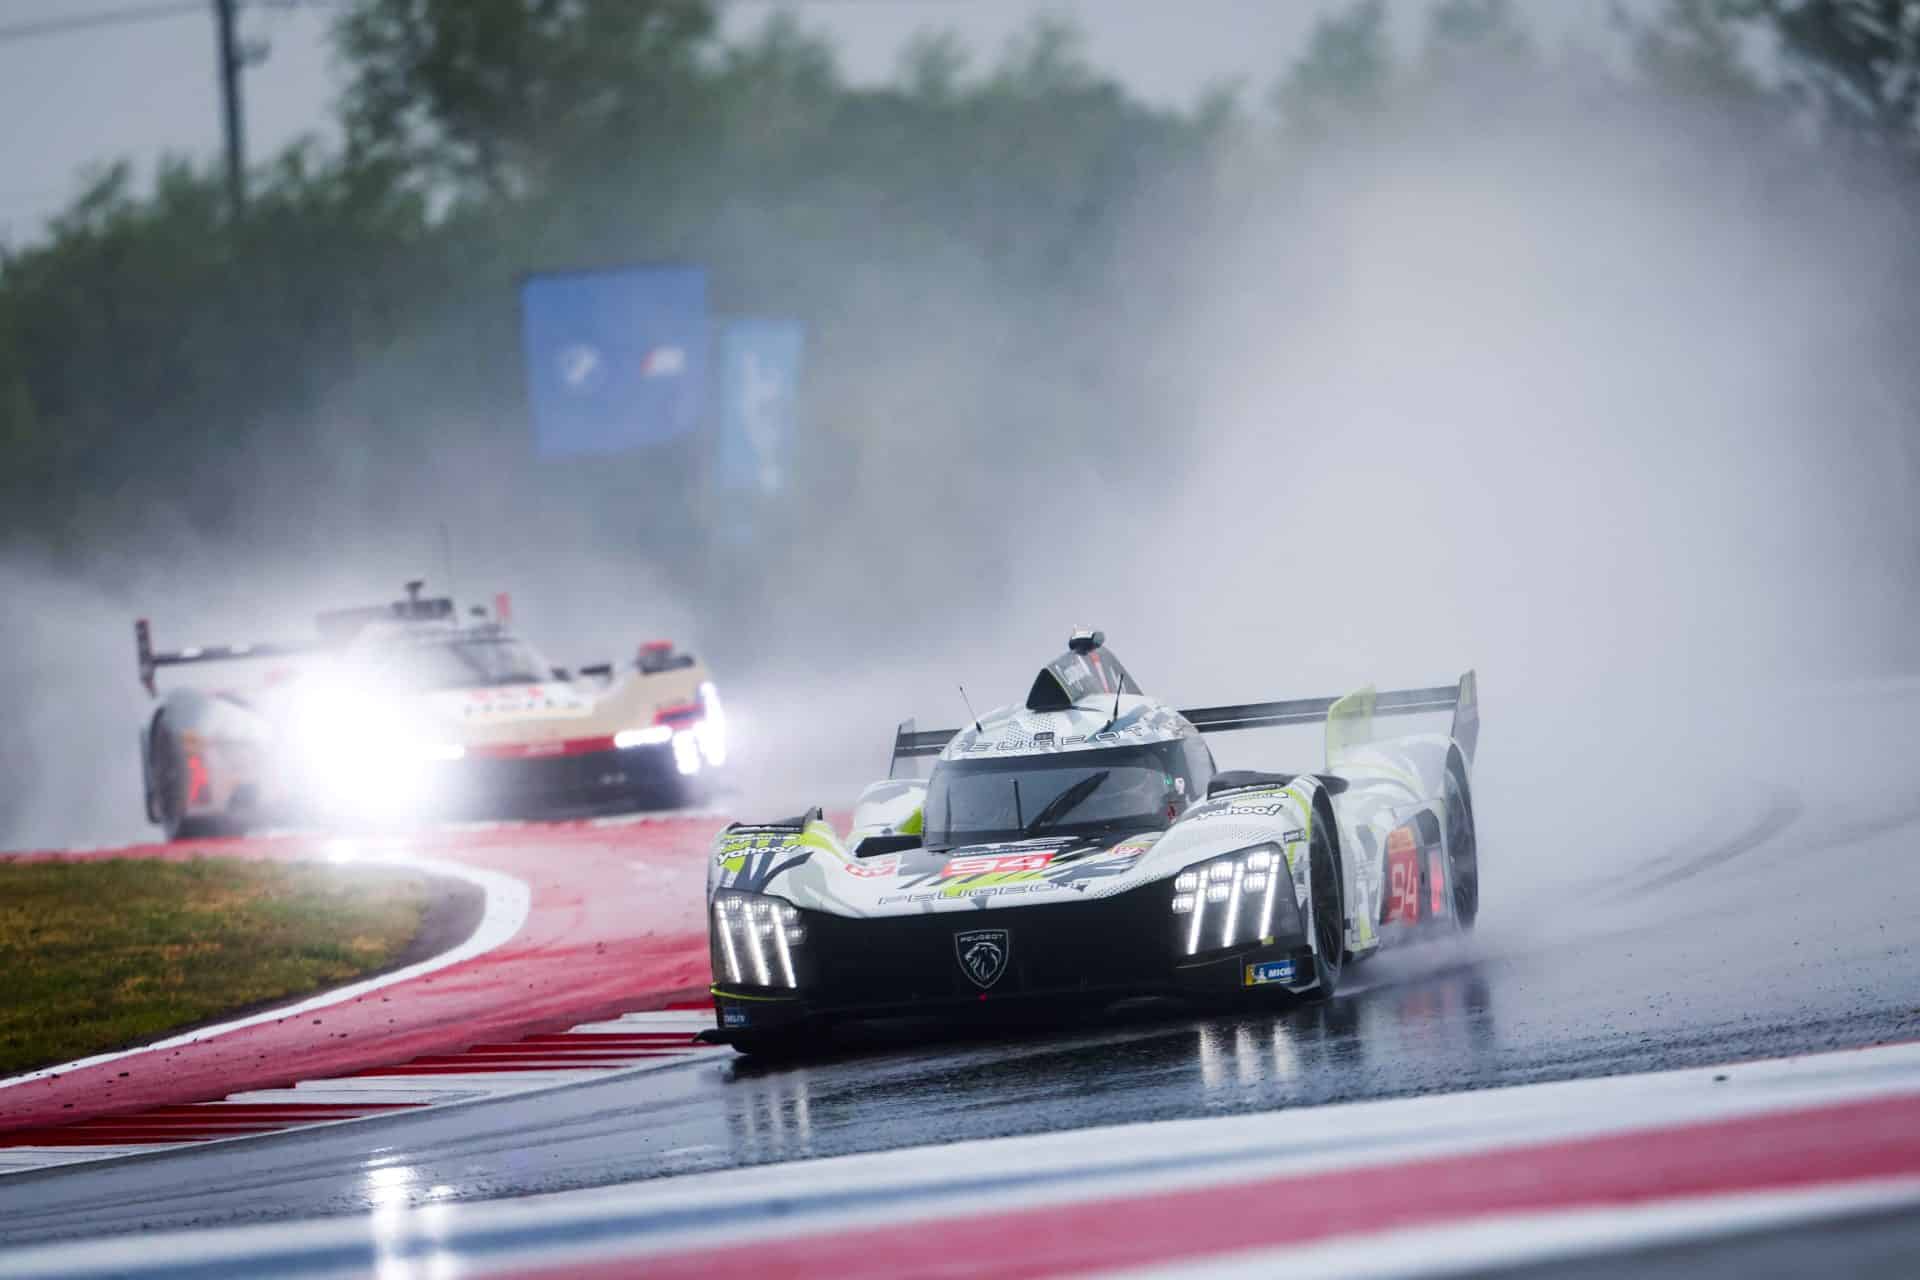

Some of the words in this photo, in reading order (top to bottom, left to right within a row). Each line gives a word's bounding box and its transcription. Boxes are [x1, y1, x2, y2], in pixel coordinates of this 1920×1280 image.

[1199, 803, 1282, 821] yahoo!
[949, 855, 1049, 875] 94
[1389, 860, 1418, 918] 94
